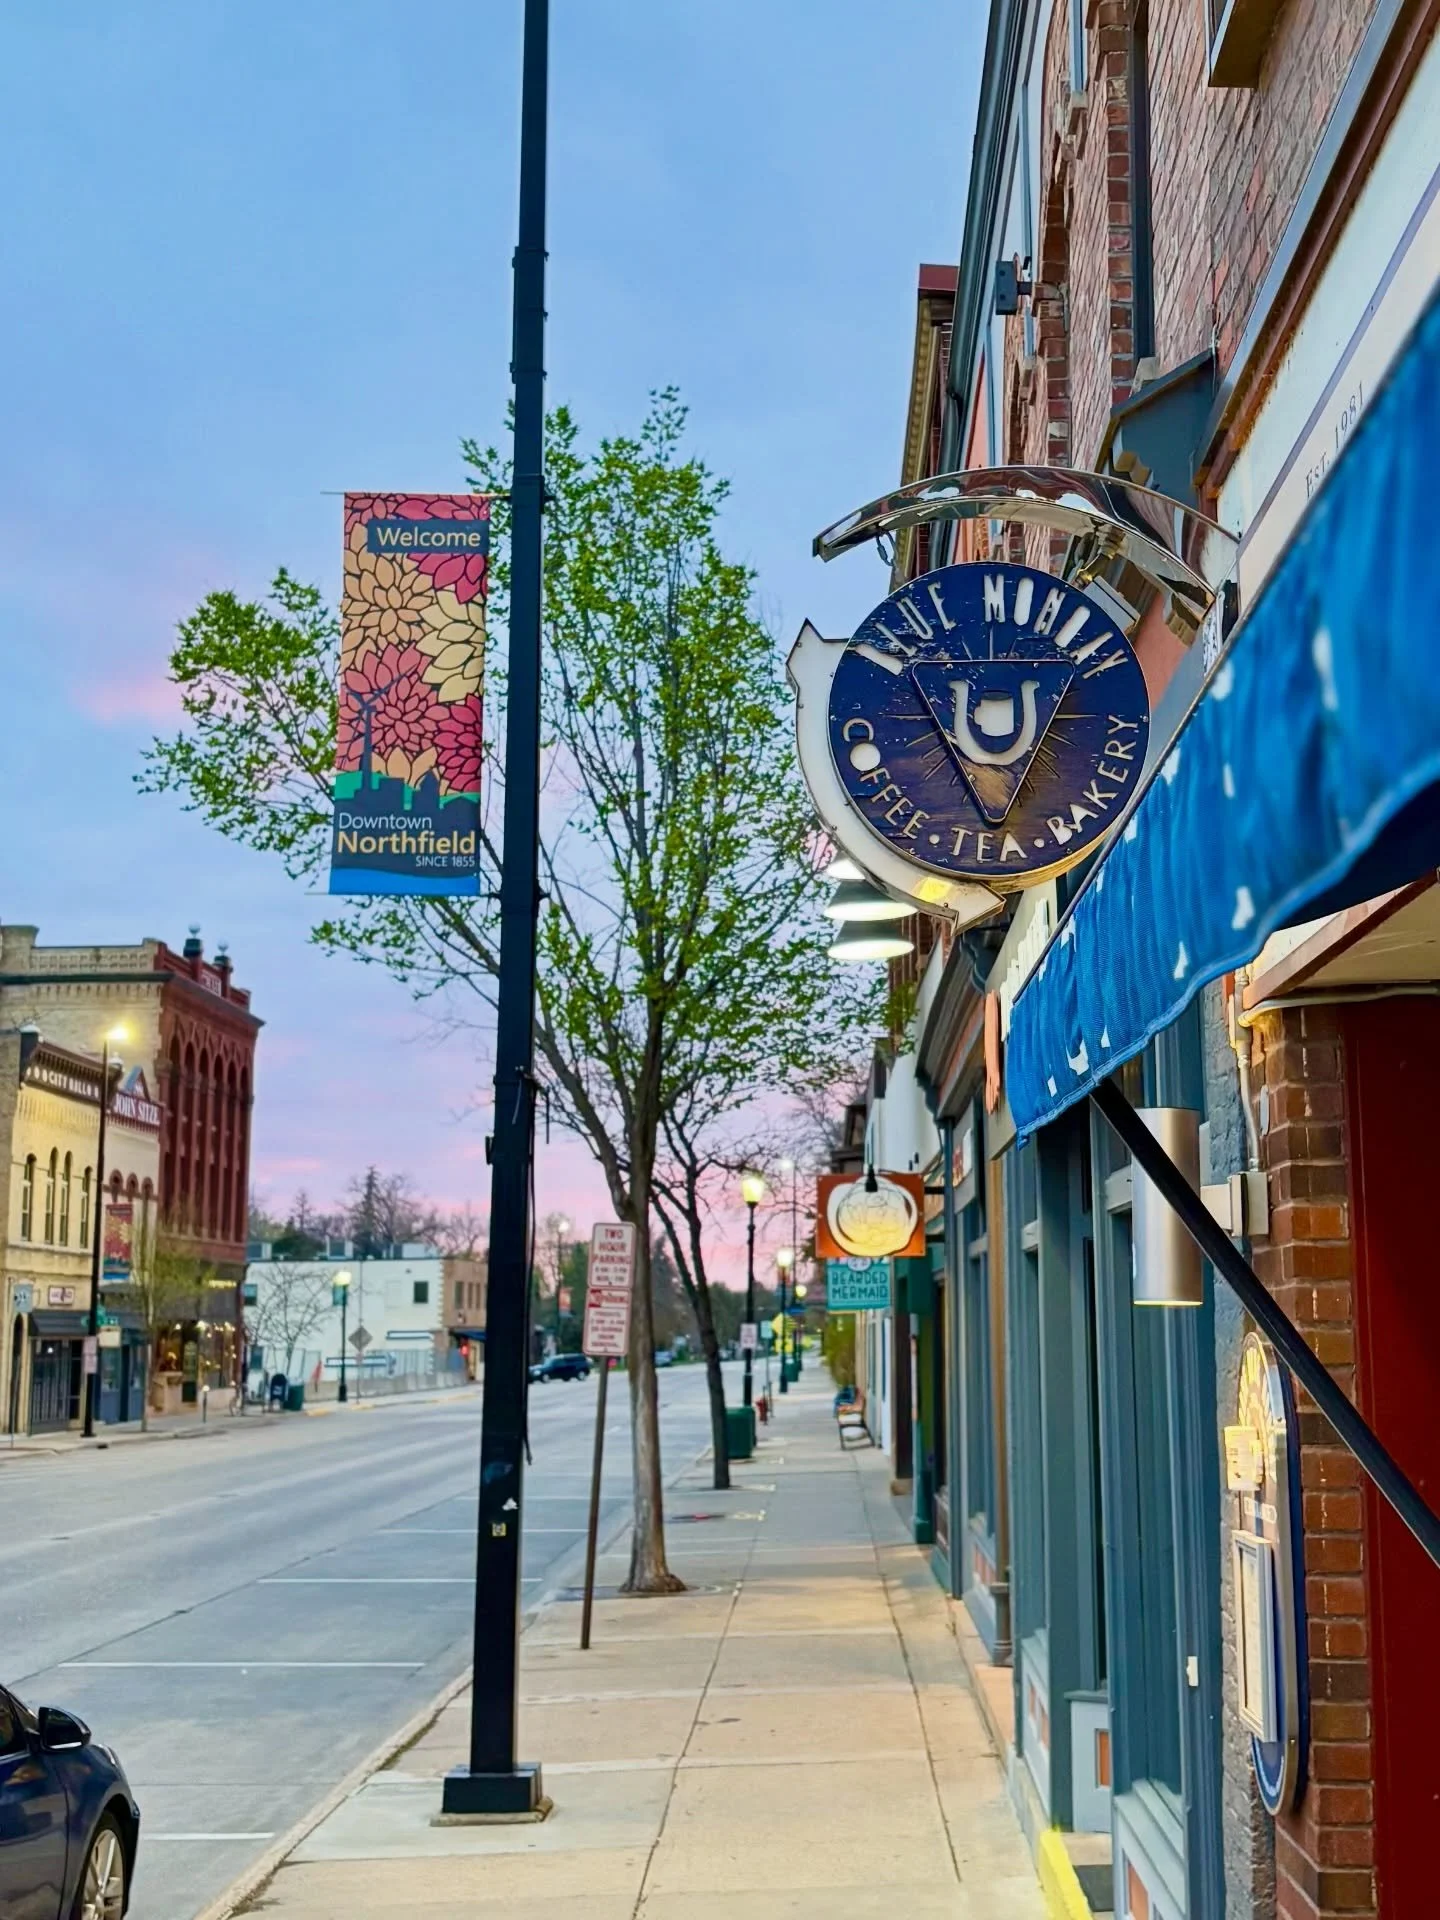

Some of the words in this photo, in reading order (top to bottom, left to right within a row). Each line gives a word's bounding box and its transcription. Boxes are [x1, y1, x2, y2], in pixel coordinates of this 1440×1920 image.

[1334, 379, 1364, 450] 1981
[376, 526, 482, 549] Welcome
[982, 572, 1129, 681] MONDAY
[842, 717, 932, 841] COFFEE
[951, 826, 1028, 863] TEA
[1046, 714, 1140, 846] BAKERY
[338, 811, 433, 830] Downtown
[337, 829, 477, 856] Northfield
[415, 855, 449, 868] SINCE
[451, 855, 476, 868] 1855
[48, 1070, 67, 1090] CITY
[113, 1093, 136, 1118] JOHN
[604, 1228, 624, 1240] TWO
[831, 1271, 888, 1286] BEARDED
[831, 1285, 889, 1300] MERMAID
